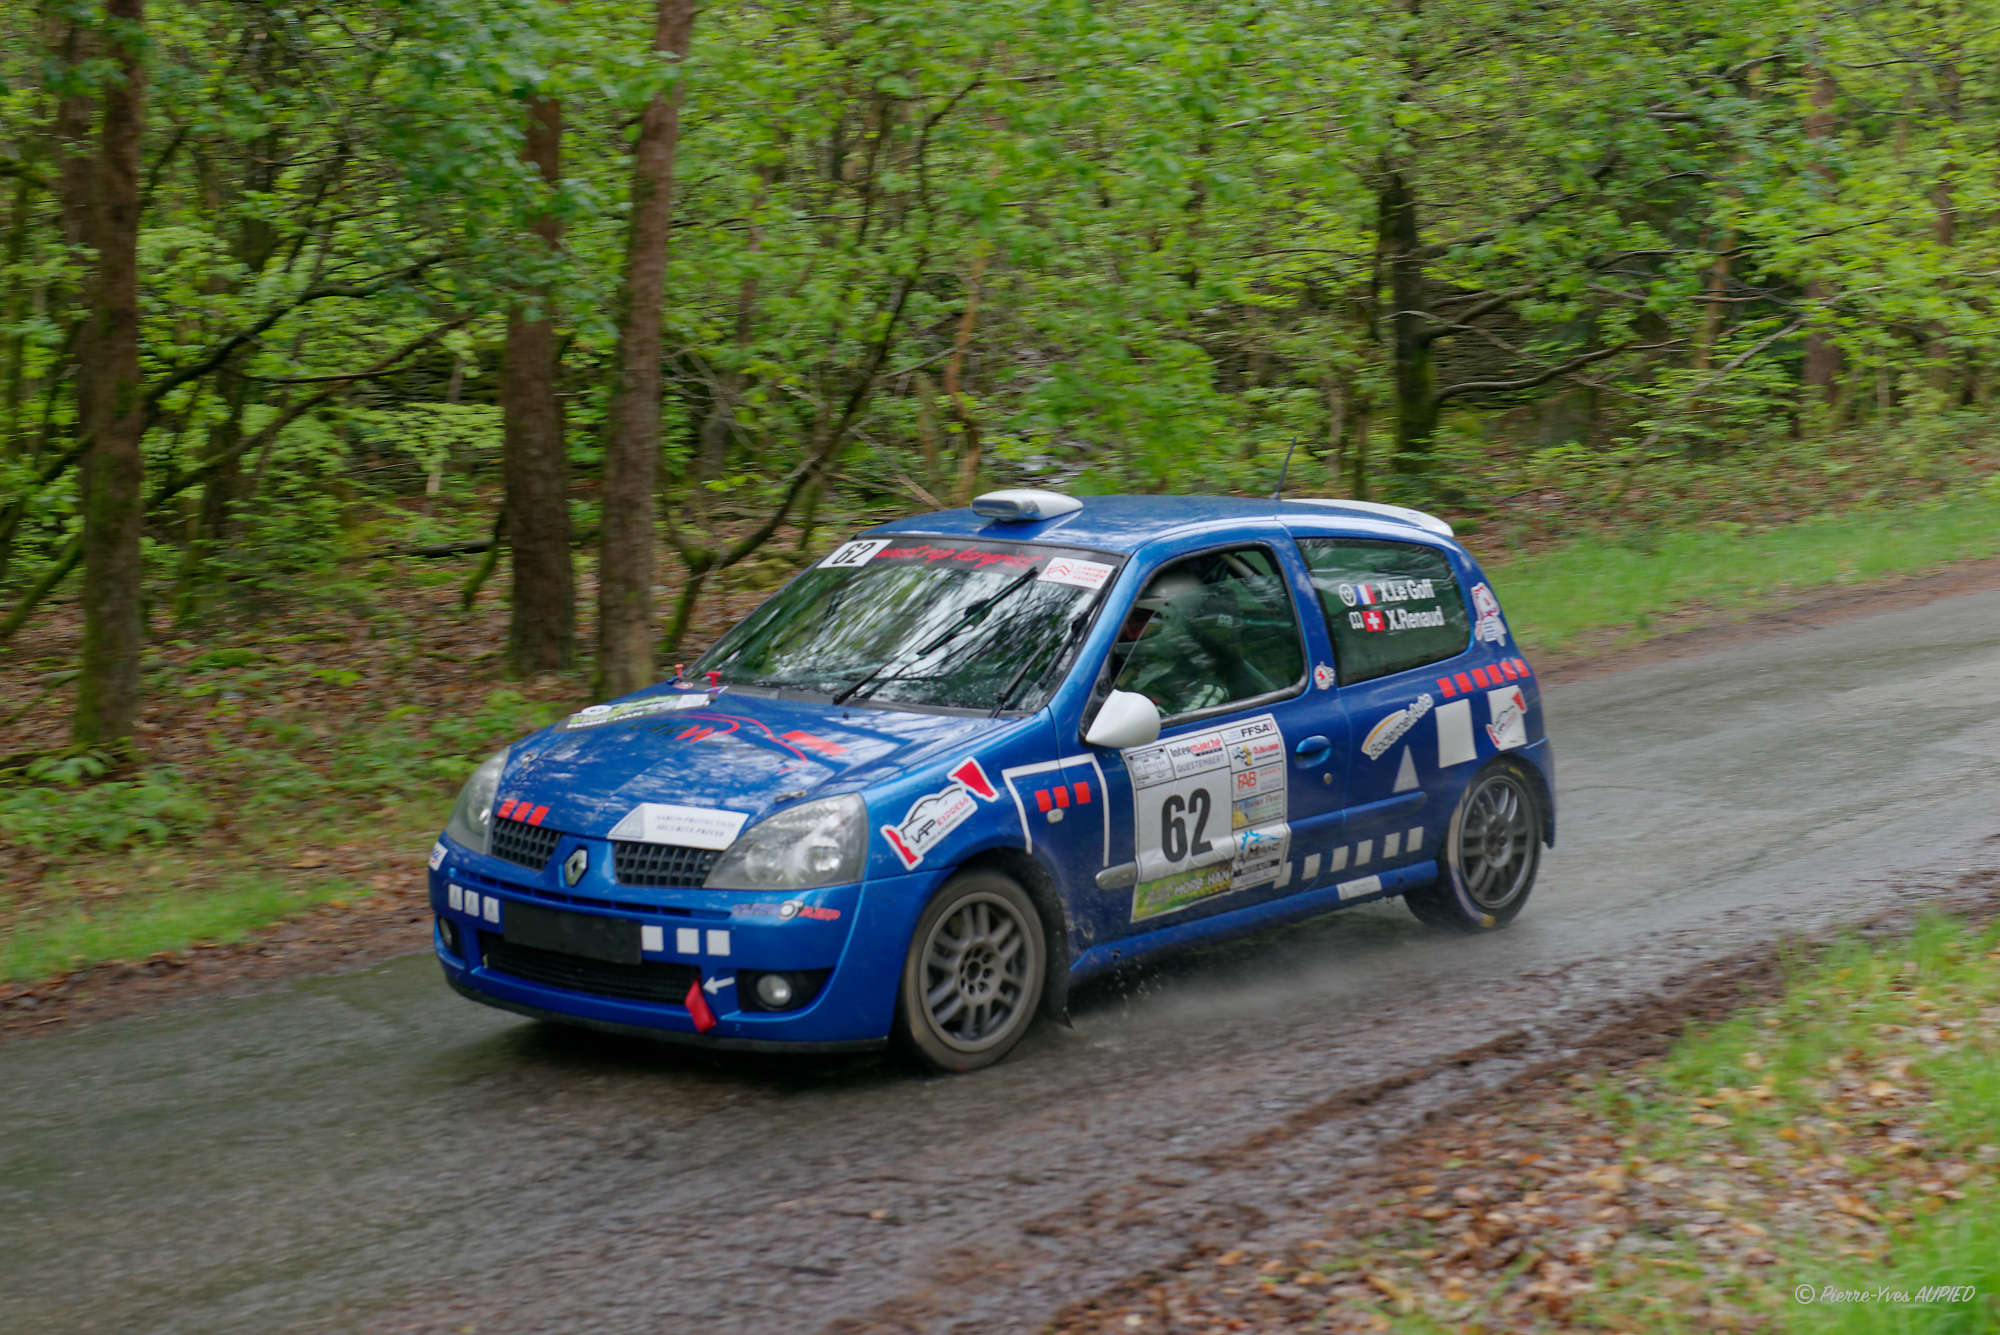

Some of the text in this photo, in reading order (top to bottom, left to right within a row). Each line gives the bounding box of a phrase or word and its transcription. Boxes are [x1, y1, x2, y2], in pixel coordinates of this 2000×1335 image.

[832, 541, 877, 565] 62
[1385, 605, 1446, 631] X.Renaud
[1240, 723, 1270, 738] FFSA
[1161, 788, 1214, 863] 62
